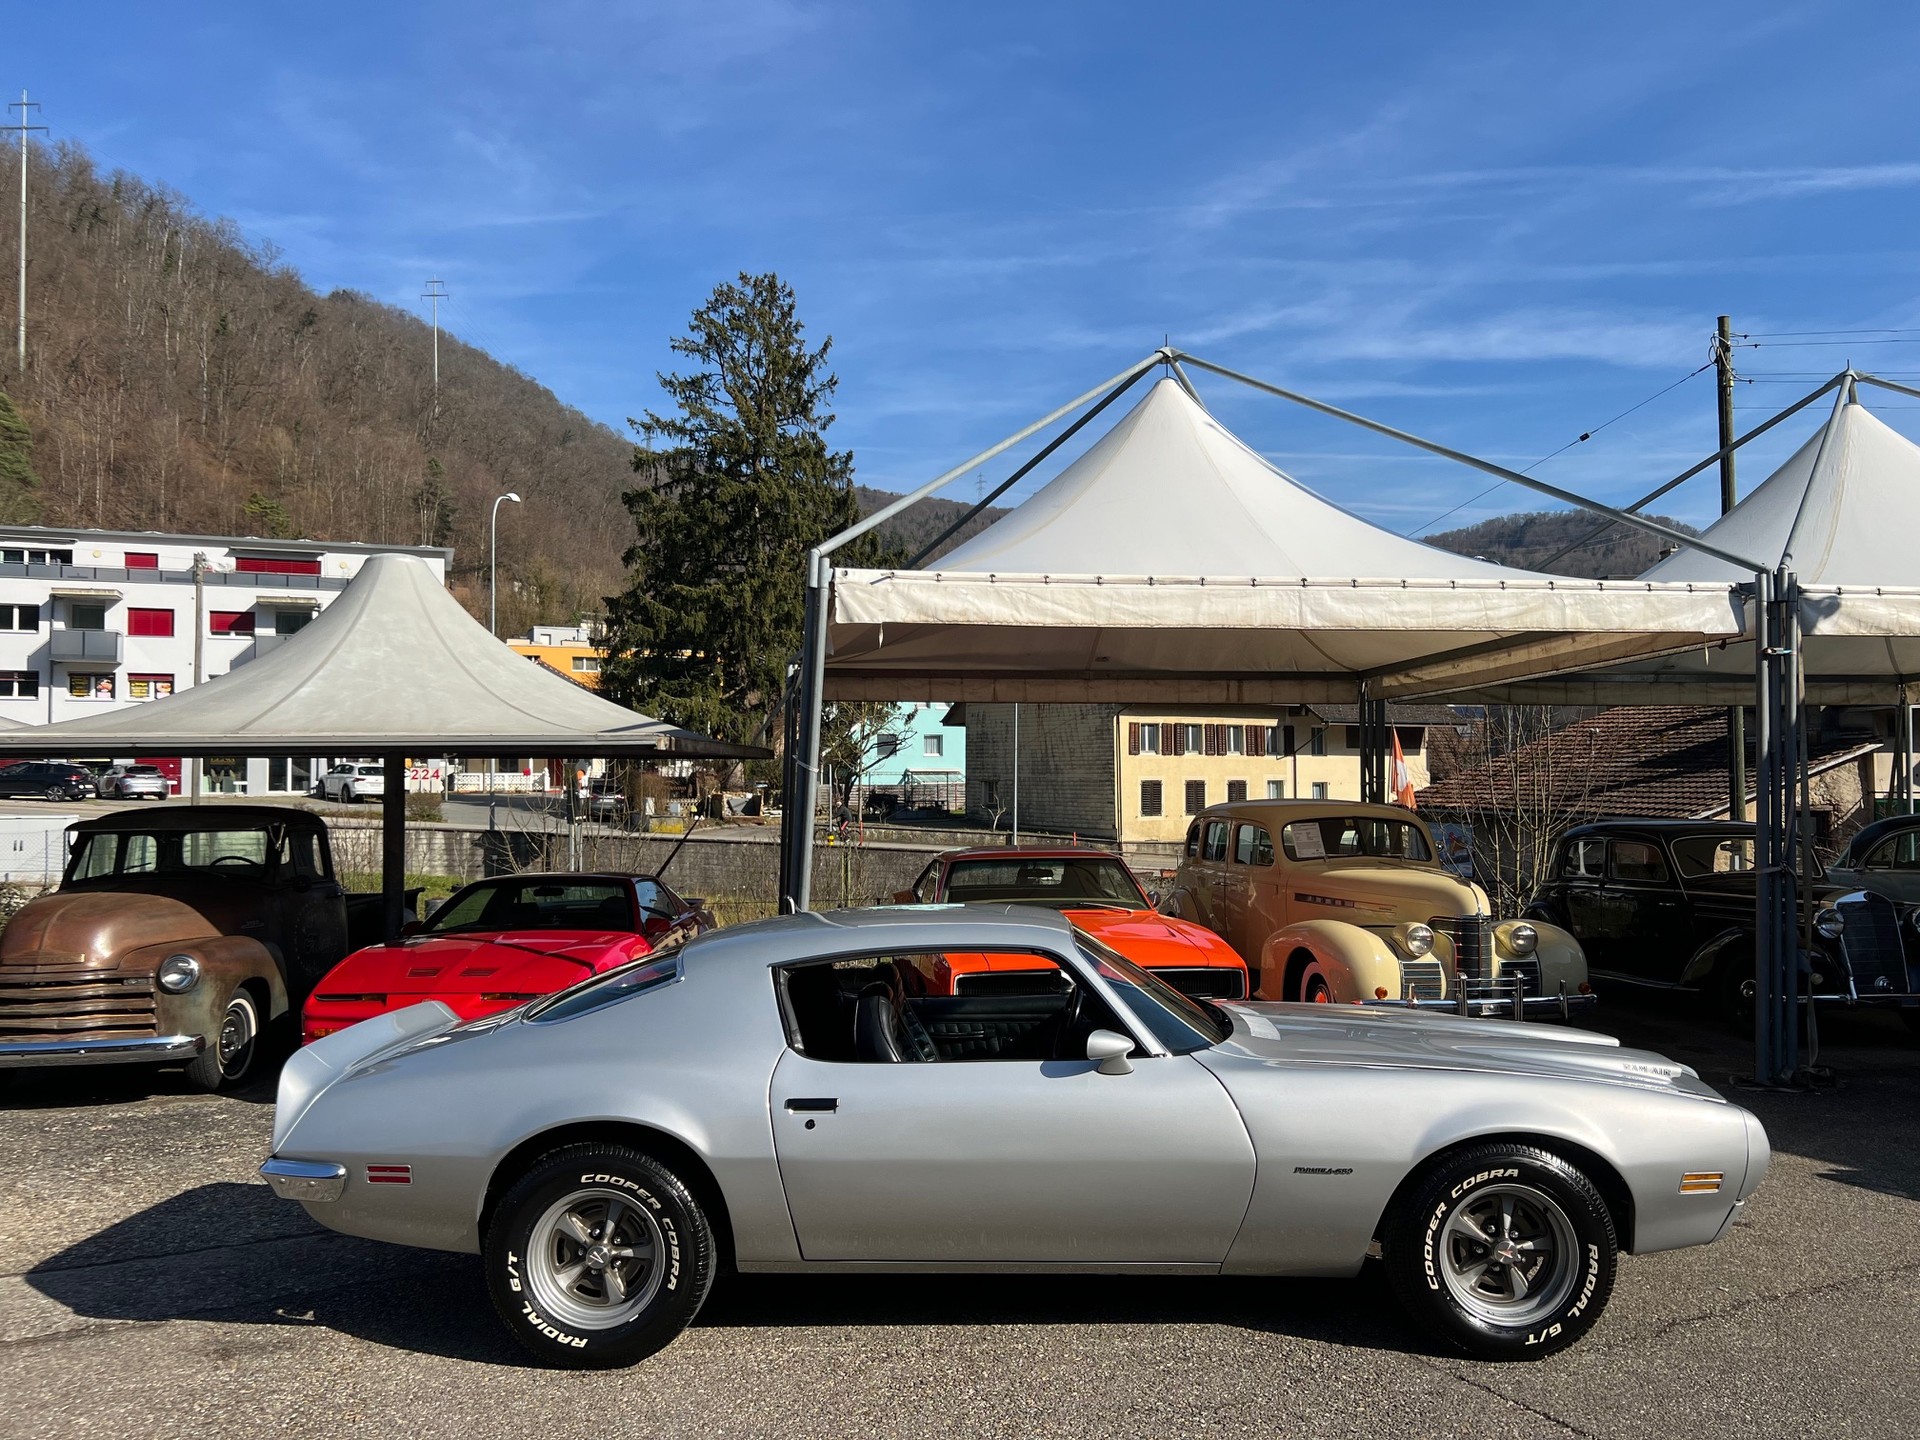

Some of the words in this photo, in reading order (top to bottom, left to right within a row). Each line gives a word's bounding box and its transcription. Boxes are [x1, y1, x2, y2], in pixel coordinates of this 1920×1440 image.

[580, 1173, 662, 1211] COOPER
[662, 1217, 680, 1291] COBRA
[1424, 1201, 1448, 1291] COOPER
[1450, 1168, 1519, 1199] COBRA
[507, 1251, 522, 1292] G/T
[1567, 1243, 1599, 1318] RADIAL
[521, 1300, 589, 1349] RADIAL
[1524, 1322, 1563, 1346] G/T
